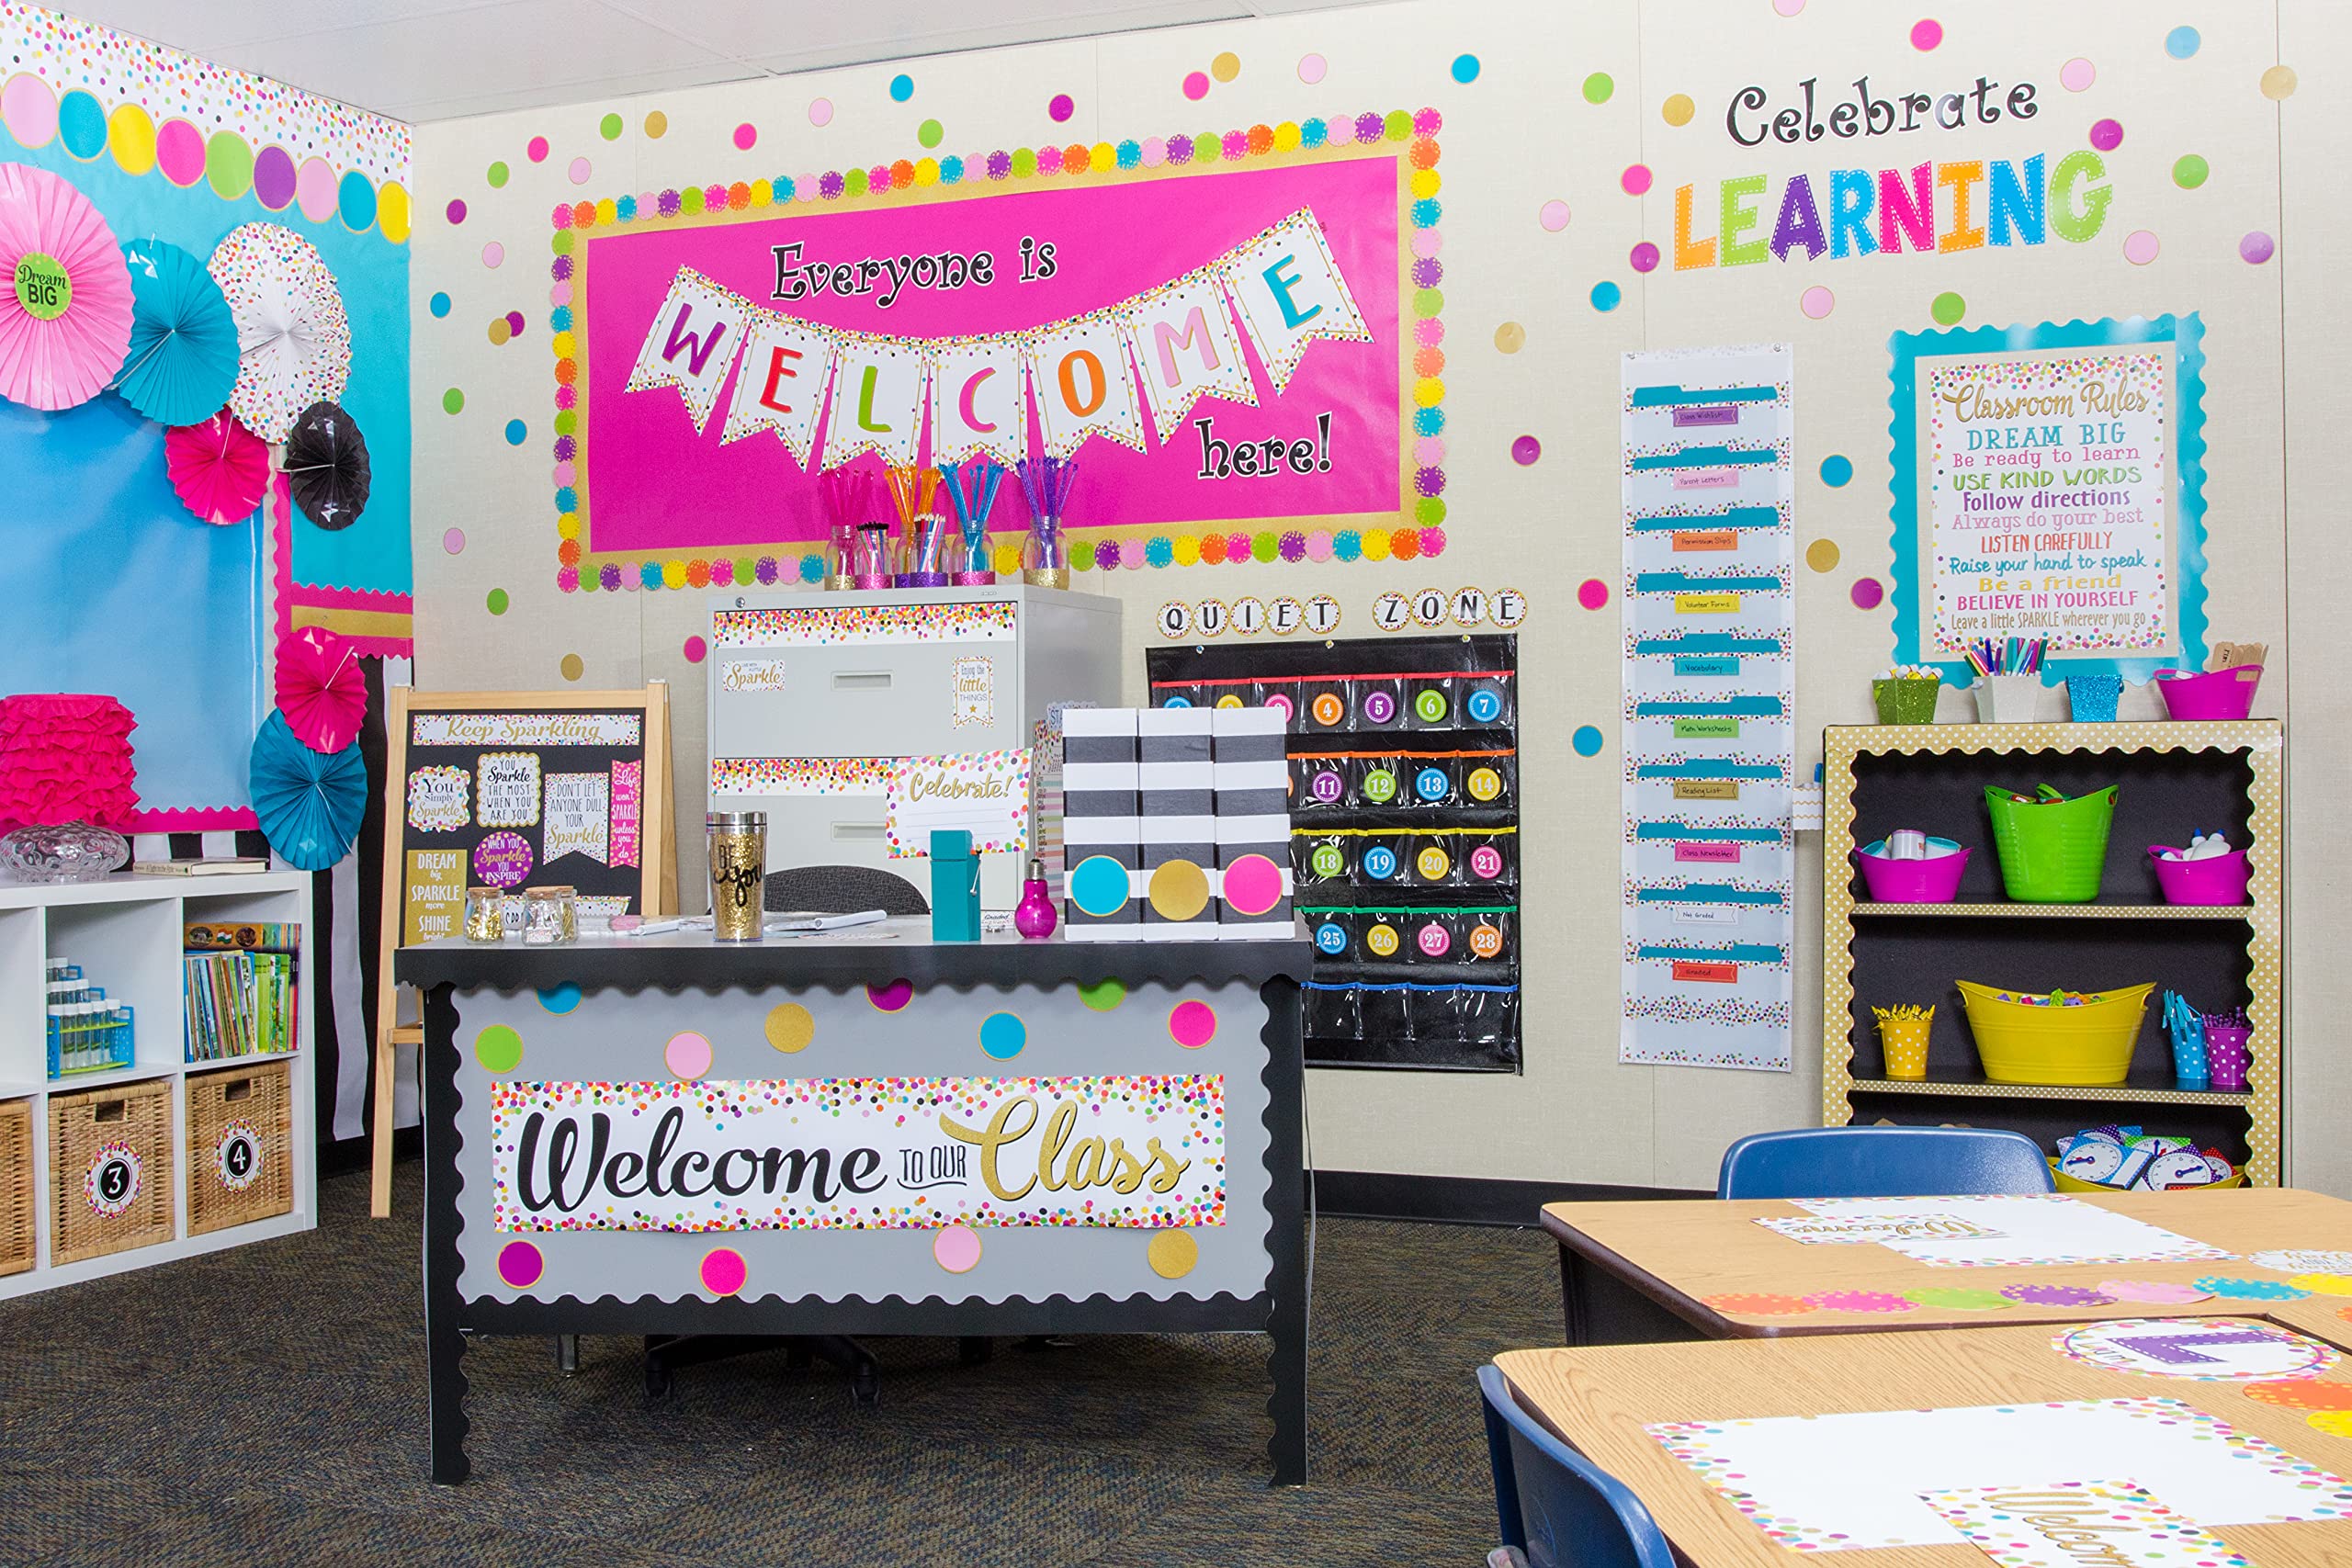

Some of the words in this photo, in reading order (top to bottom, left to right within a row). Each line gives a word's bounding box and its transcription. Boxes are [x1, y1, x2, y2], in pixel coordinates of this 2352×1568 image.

[1726, 75, 2040, 147] Celebrate
[1674, 150, 2112, 271] LEARNING
[18, 265, 66, 289] Dream
[772, 241, 994, 307] Everyone
[1020, 237, 1057, 282] is
[28, 283, 57, 306] BIG
[663, 253, 1324, 434] WELCOME
[1941, 383, 2074, 422] Classroom
[2080, 376, 2149, 418] Rules
[1967, 425, 2064, 450] DREAM
[2080, 423, 2126, 445] BIG
[1195, 414, 1332, 479] here!
[1953, 453, 1974, 468] Be
[1984, 450, 2041, 468] ready
[2052, 448, 2072, 464] to
[2083, 447, 2141, 462] learn
[1953, 473, 1991, 491] USE
[2000, 469, 2053, 489] KIND
[2063, 467, 2142, 486] WORDS
[1963, 491, 2024, 512] Follow
[2031, 490, 2131, 508] directions
[1952, 513, 2021, 533] Always
[2026, 513, 2046, 528] do
[2052, 513, 2097, 530] your
[2102, 508, 2143, 524] best
[1981, 535, 2030, 554] LISTEN
[2034, 531, 2113, 551] CAREFULLY
[1950, 557, 1991, 575] Raise
[1996, 558, 2027, 577] your
[2033, 552, 2072, 571] hand
[2077, 555, 2096, 569] to
[2101, 548, 2147, 576] speak
[1978, 577, 2008, 592] Be
[2019, 580, 2032, 592] a
[2043, 573, 2121, 590] friend
[1957, 593, 2024, 611] BELIEVE
[2031, 592, 2048, 608] IN
[2053, 591, 2138, 608] YOURSELF
[1165, 603, 1330, 631] QUIET
[1383, 592, 1514, 623] ZONE
[1951, 614, 1979, 630] Leave
[1982, 616, 1987, 628] a
[1990, 612, 2015, 629] little
[2018, 612, 2060, 628] SPARKLE
[2062, 613, 2109, 627] wherever
[2112, 614, 2131, 629] you
[2133, 613, 2145, 629] go
[727, 663, 780, 689] Sparkle
[1685, 663, 1724, 673] Vocabulary
[959, 678, 987, 692] little
[959, 694, 988, 702] THINGS
[1323, 701, 1333, 718] 4
[1374, 700, 1384, 716] 5
[1426, 699, 1436, 715] 6
[1480, 698, 1489, 714] 7
[447, 717, 493, 741] Keep
[500, 717, 604, 742] Sparkling
[488, 766, 531, 784] Sparkle
[500, 760, 515, 771] YOU
[423, 778, 454, 794] You
[615, 770, 637, 787] Life
[910, 772, 1014, 802] Celebrate!
[1319, 780, 1336, 795] 11
[1371, 778, 1389, 793] 12
[1424, 776, 1442, 792] 13
[1476, 776, 1494, 792] 14
[489, 785, 505, 795] THE
[507, 784, 530, 795] MOST
[557, 783, 581, 797] DON'T
[584, 784, 596, 796] LET
[616, 790, 635, 801] won't
[416, 800, 460, 818] Sparkle
[424, 794, 454, 805] Simply
[487, 797, 511, 808] WHEN
[515, 796, 531, 807] YOU
[551, 798, 582, 812] ANYONE
[586, 798, 602, 812] DULL
[491, 810, 506, 820] ARE
[512, 809, 527, 820] YOU
[565, 814, 584, 827] YOUR
[612, 804, 638, 820] SPARKLE
[547, 823, 604, 849] Sparkle
[615, 821, 635, 834] unless
[487, 838, 504, 850] WHEN
[507, 838, 520, 849] YOU
[617, 836, 631, 846] you
[418, 853, 457, 869] DREAM
[480, 847, 526, 866] Sparkle
[618, 847, 629, 859] do
[718, 845, 736, 869] BE
[1318, 854, 1337, 870] 18
[1371, 854, 1390, 870] 19
[1424, 856, 1442, 871] 20
[1477, 854, 1496, 869] 21
[430, 870, 443, 881] big
[487, 871, 521, 881] INSPIRE
[498, 862, 510, 872] YOU
[412, 885, 459, 902] SPARKLE
[419, 915, 451, 932] SHINE
[1323, 931, 1340, 945] 25
[1374, 932, 1392, 947] 26
[1424, 932, 1443, 947] 27
[1476, 933, 1496, 949] 28
[938, 1094, 1192, 1201] Class
[233, 1145, 245, 1170] 4
[517, 1105, 888, 1213] Welcome
[899, 1148, 923, 1182] TO
[930, 1145, 967, 1179] OUR
[108, 1167, 122, 1194] 3
[1784, 1220, 1980, 1235] Welcome
[1982, 1492, 2143, 1568] Welcom
